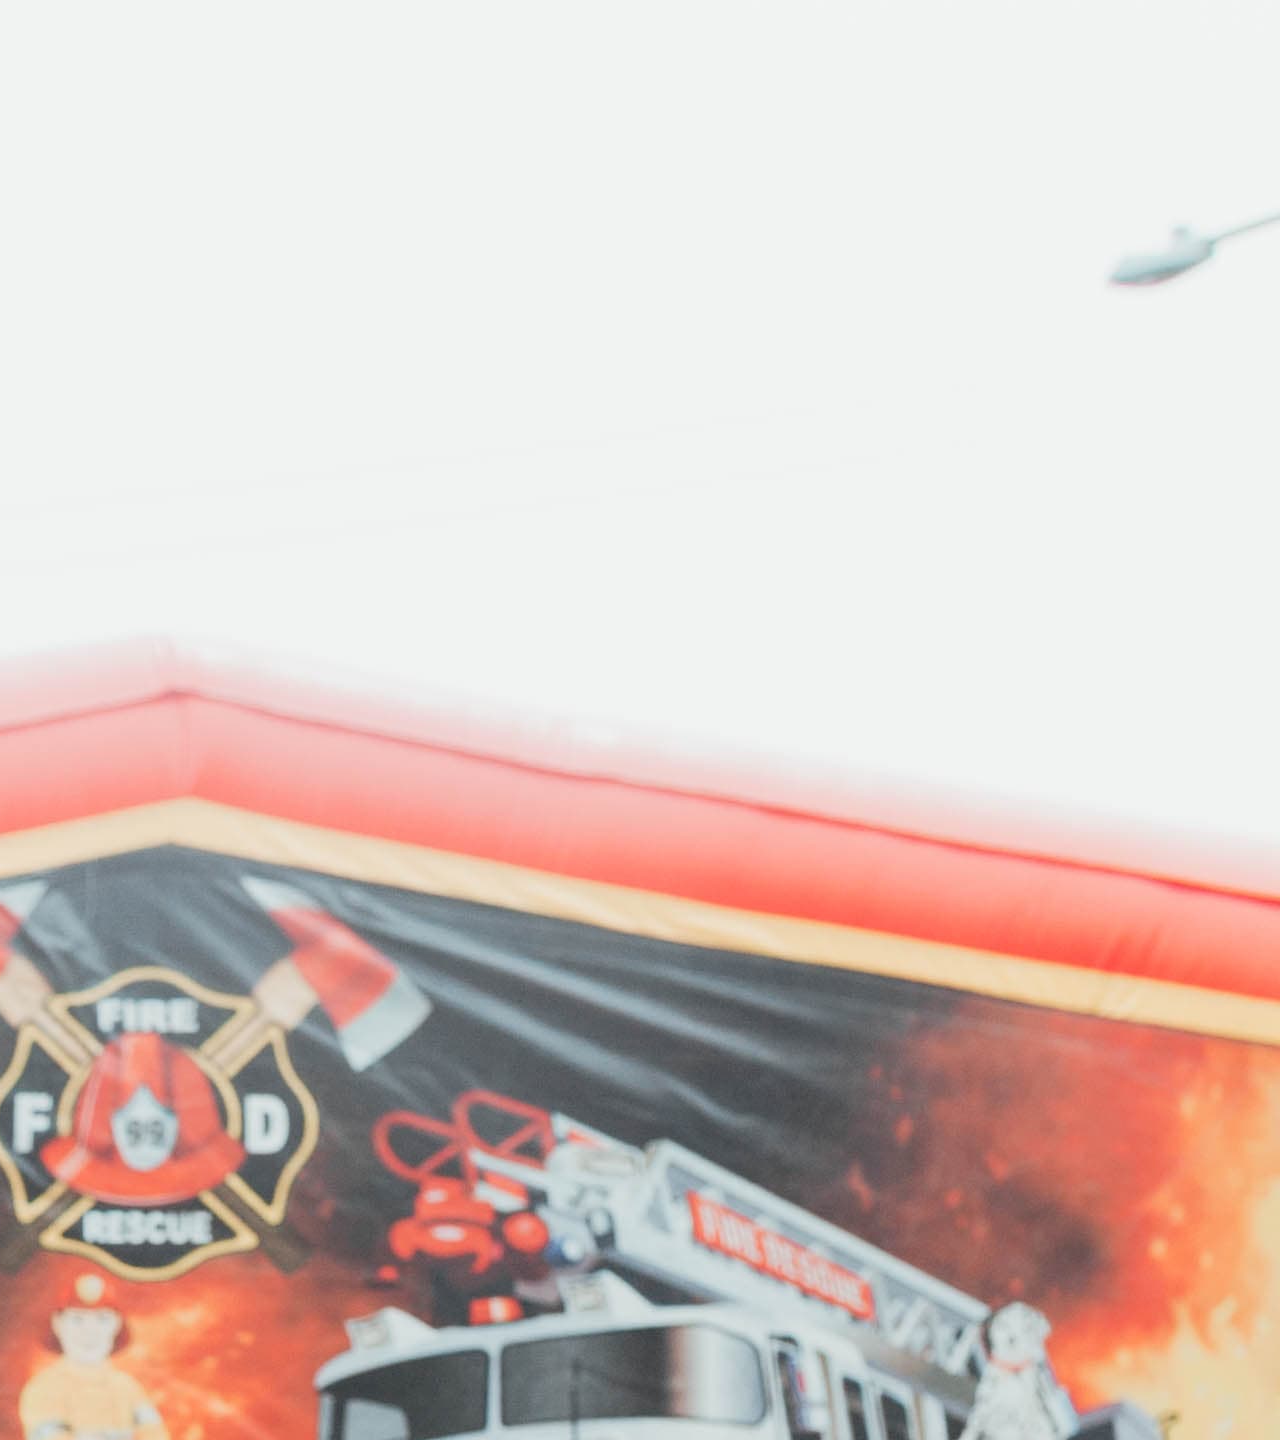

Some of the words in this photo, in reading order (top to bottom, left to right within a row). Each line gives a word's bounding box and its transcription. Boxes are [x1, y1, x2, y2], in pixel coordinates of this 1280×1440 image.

[96, 998, 200, 1033] FIRE
[12, 1092, 53, 1154] F
[128, 1121, 164, 1146] 99
[244, 1094, 290, 1154] D
[82, 1210, 213, 1245] RESCUE
[700, 1202, 761, 1262] FIRE
